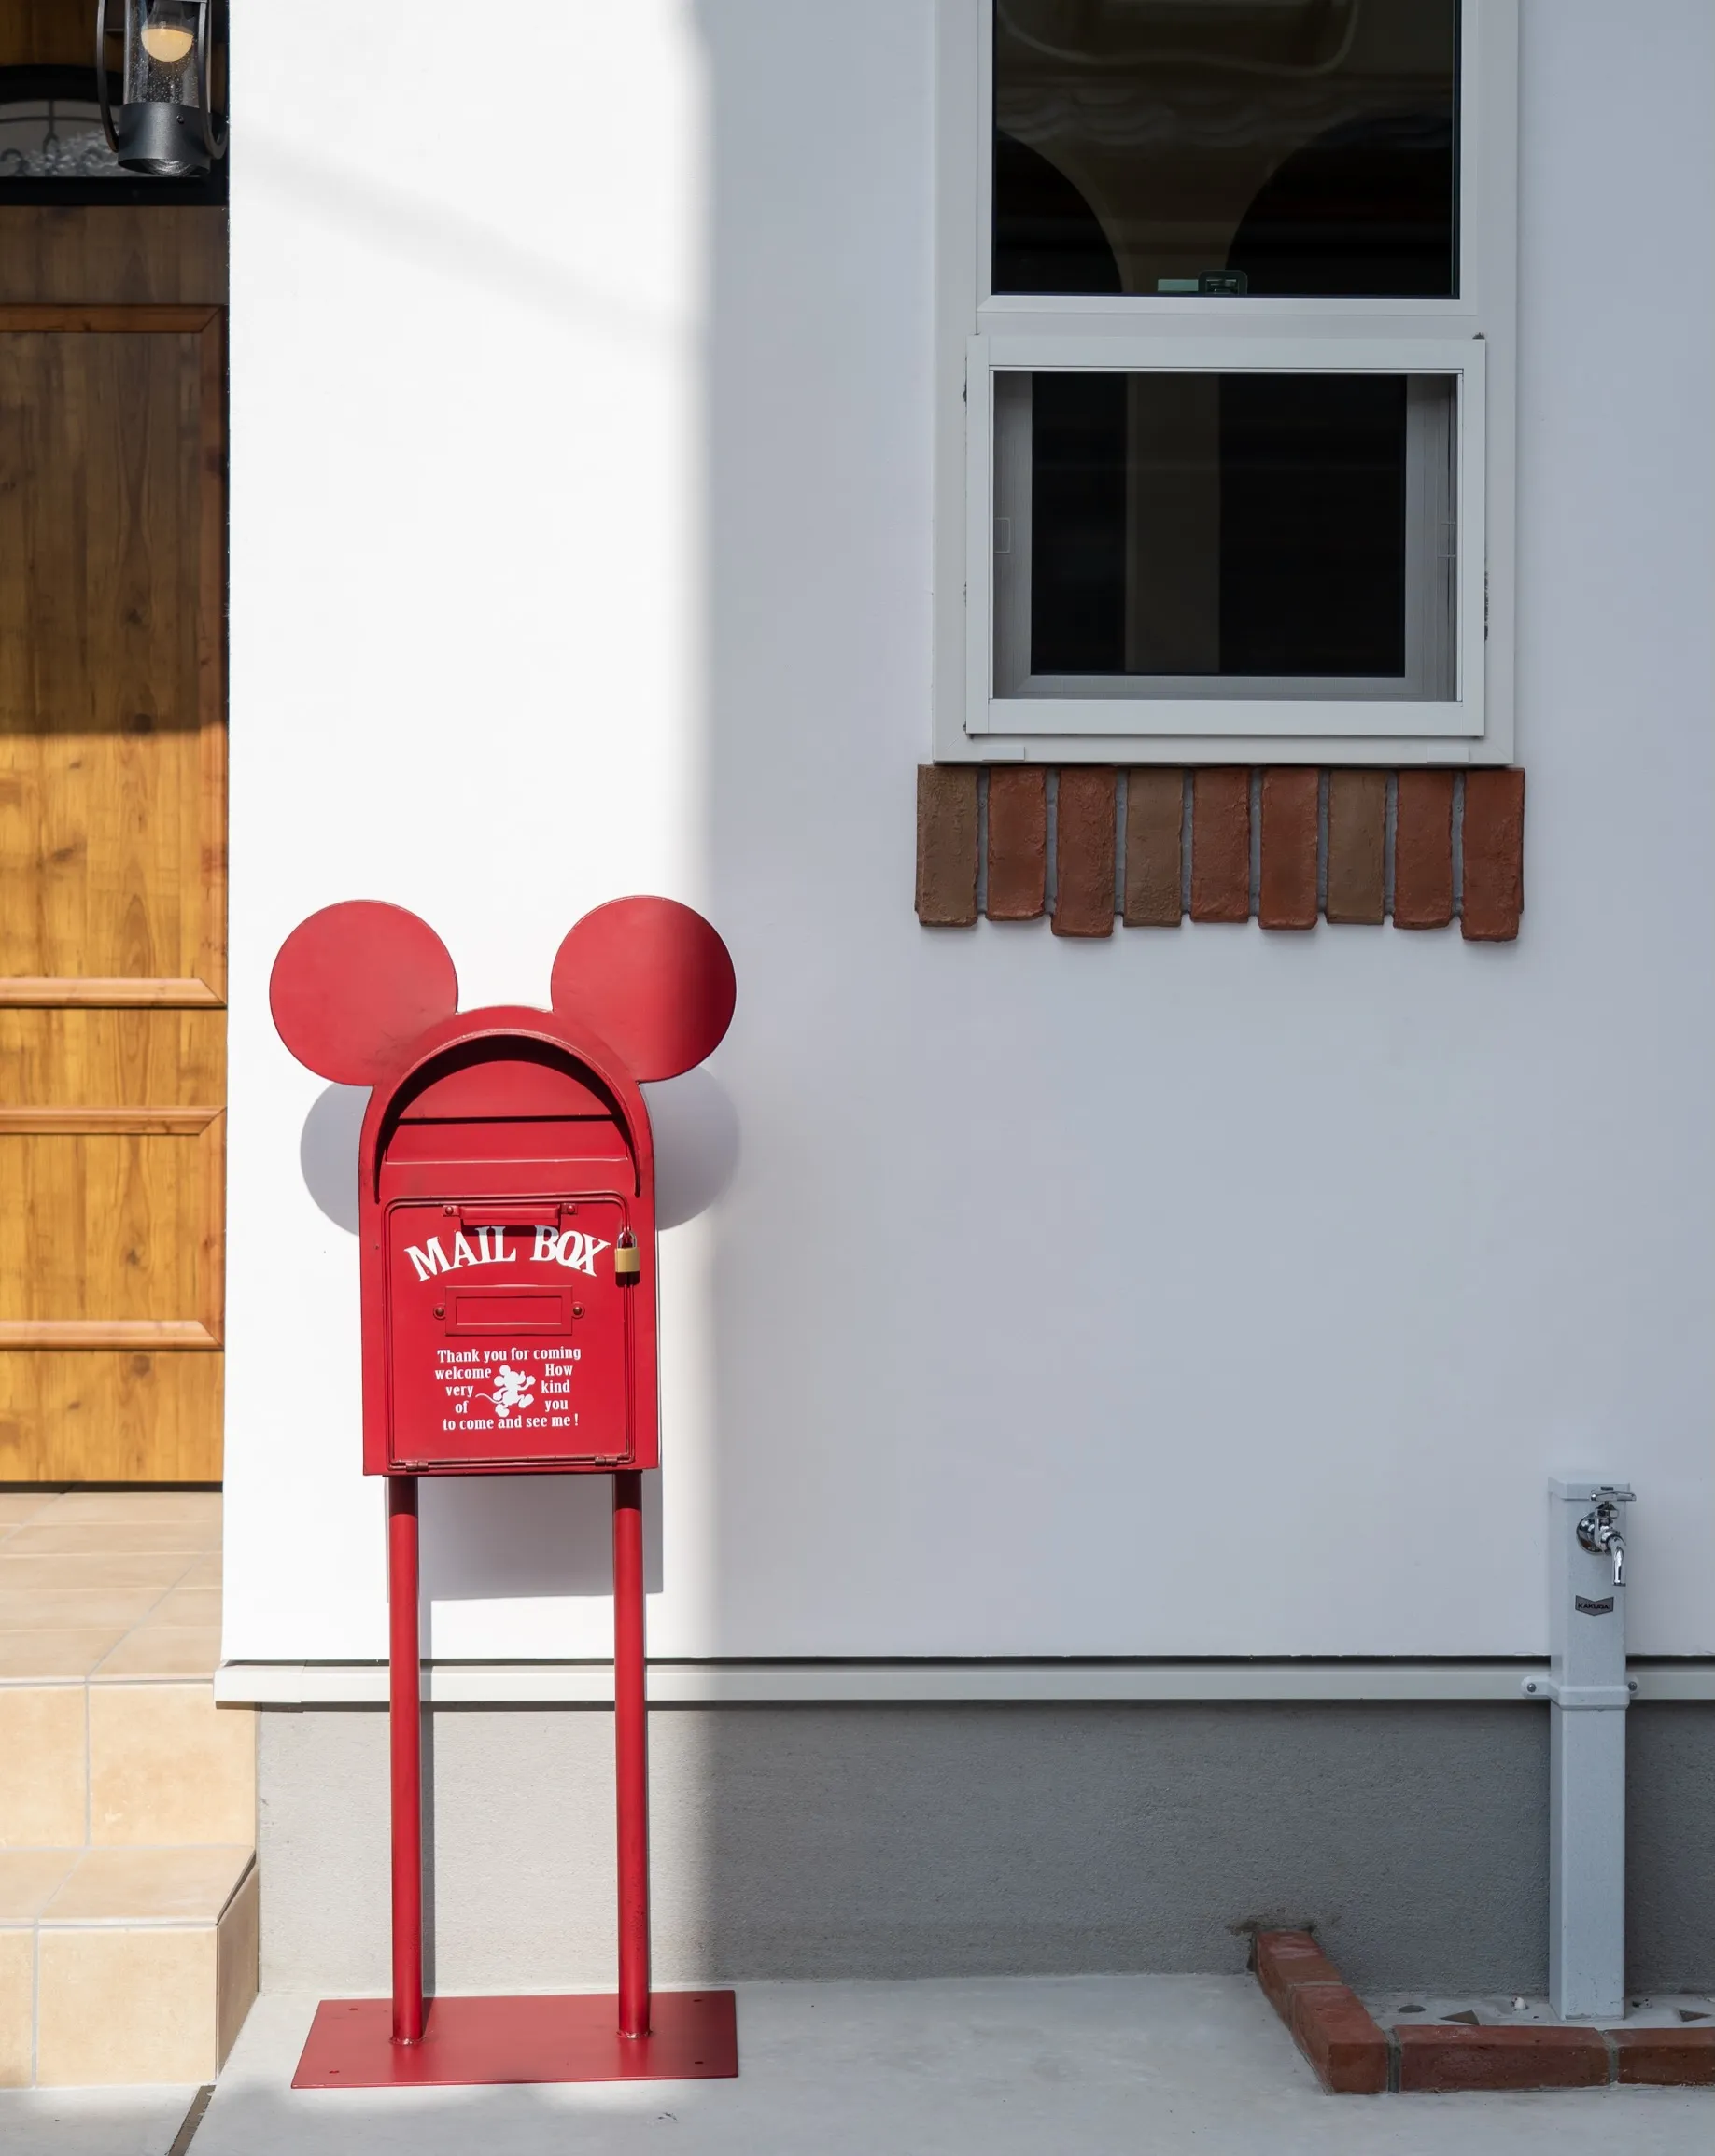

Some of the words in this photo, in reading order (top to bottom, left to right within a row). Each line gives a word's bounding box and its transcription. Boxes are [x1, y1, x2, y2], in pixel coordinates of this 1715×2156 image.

[403, 1225, 516, 1281] MAIL
[530, 1225, 611, 1277] BOX
[437, 1348, 480, 1363] Thank
[484, 1350, 507, 1363] you
[511, 1347, 529, 1361] for
[533, 1346, 581, 1361] coming
[435, 1366, 491, 1380] welcome
[545, 1364, 573, 1377] How
[446, 1385, 473, 1398] very
[541, 1379, 570, 1393] kind
[455, 1400, 469, 1414] of
[545, 1399, 568, 1412] you
[443, 1417, 456, 1431] to
[459, 1419, 494, 1430] come
[498, 1414, 522, 1429] and
[526, 1417, 548, 1428] see
